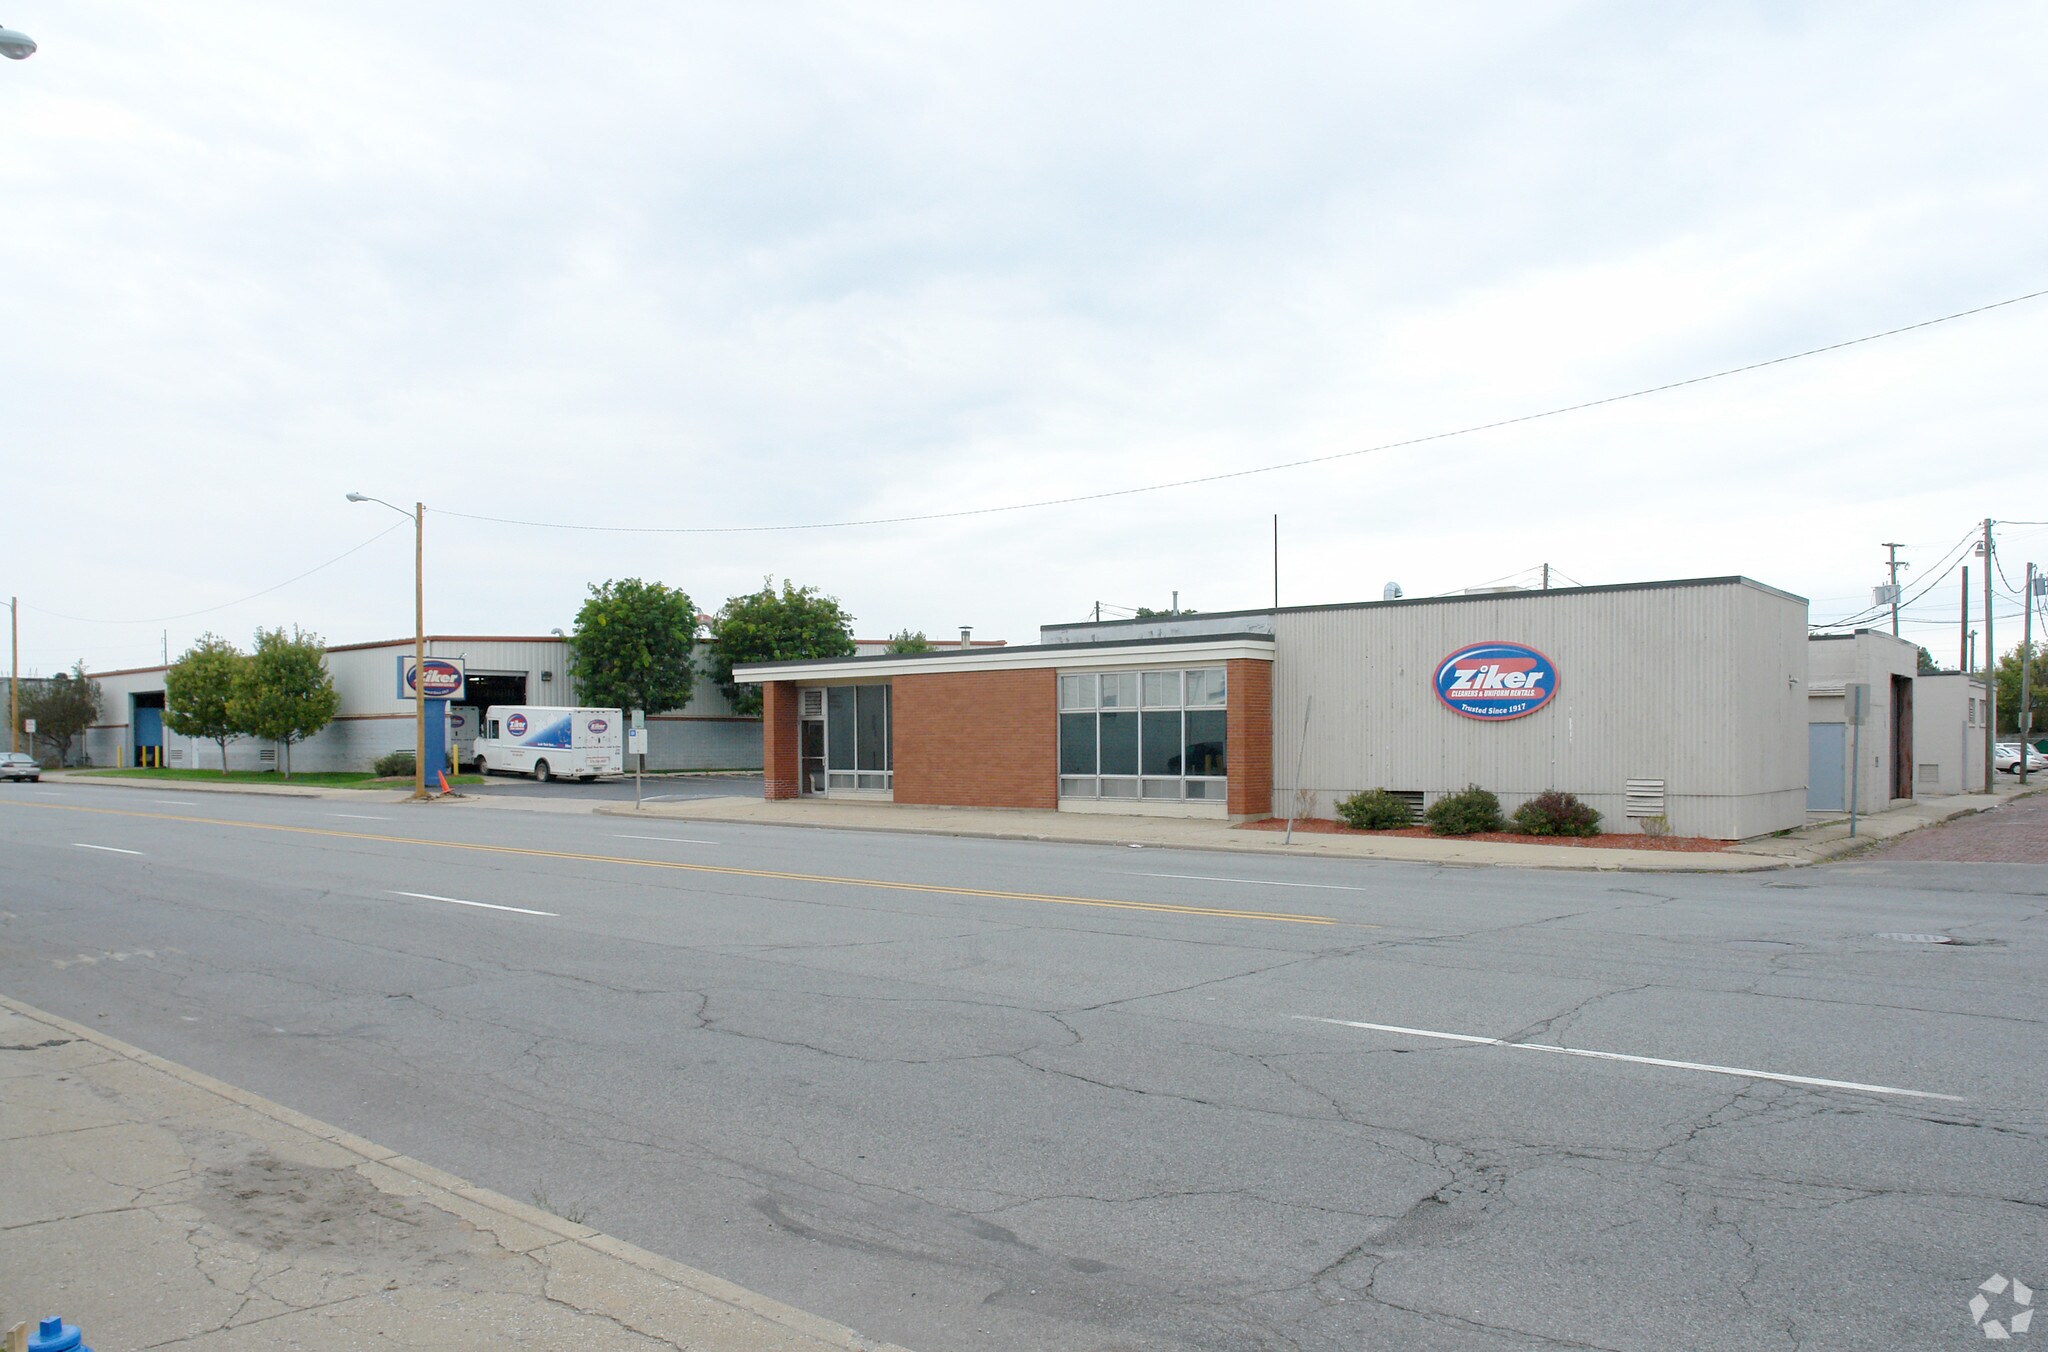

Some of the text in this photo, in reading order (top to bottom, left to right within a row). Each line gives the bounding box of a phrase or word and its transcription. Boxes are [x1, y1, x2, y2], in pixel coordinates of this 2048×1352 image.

[1449, 665, 1544, 689] Ziker
[1461, 703, 1526, 714] Trusted Since 1917
